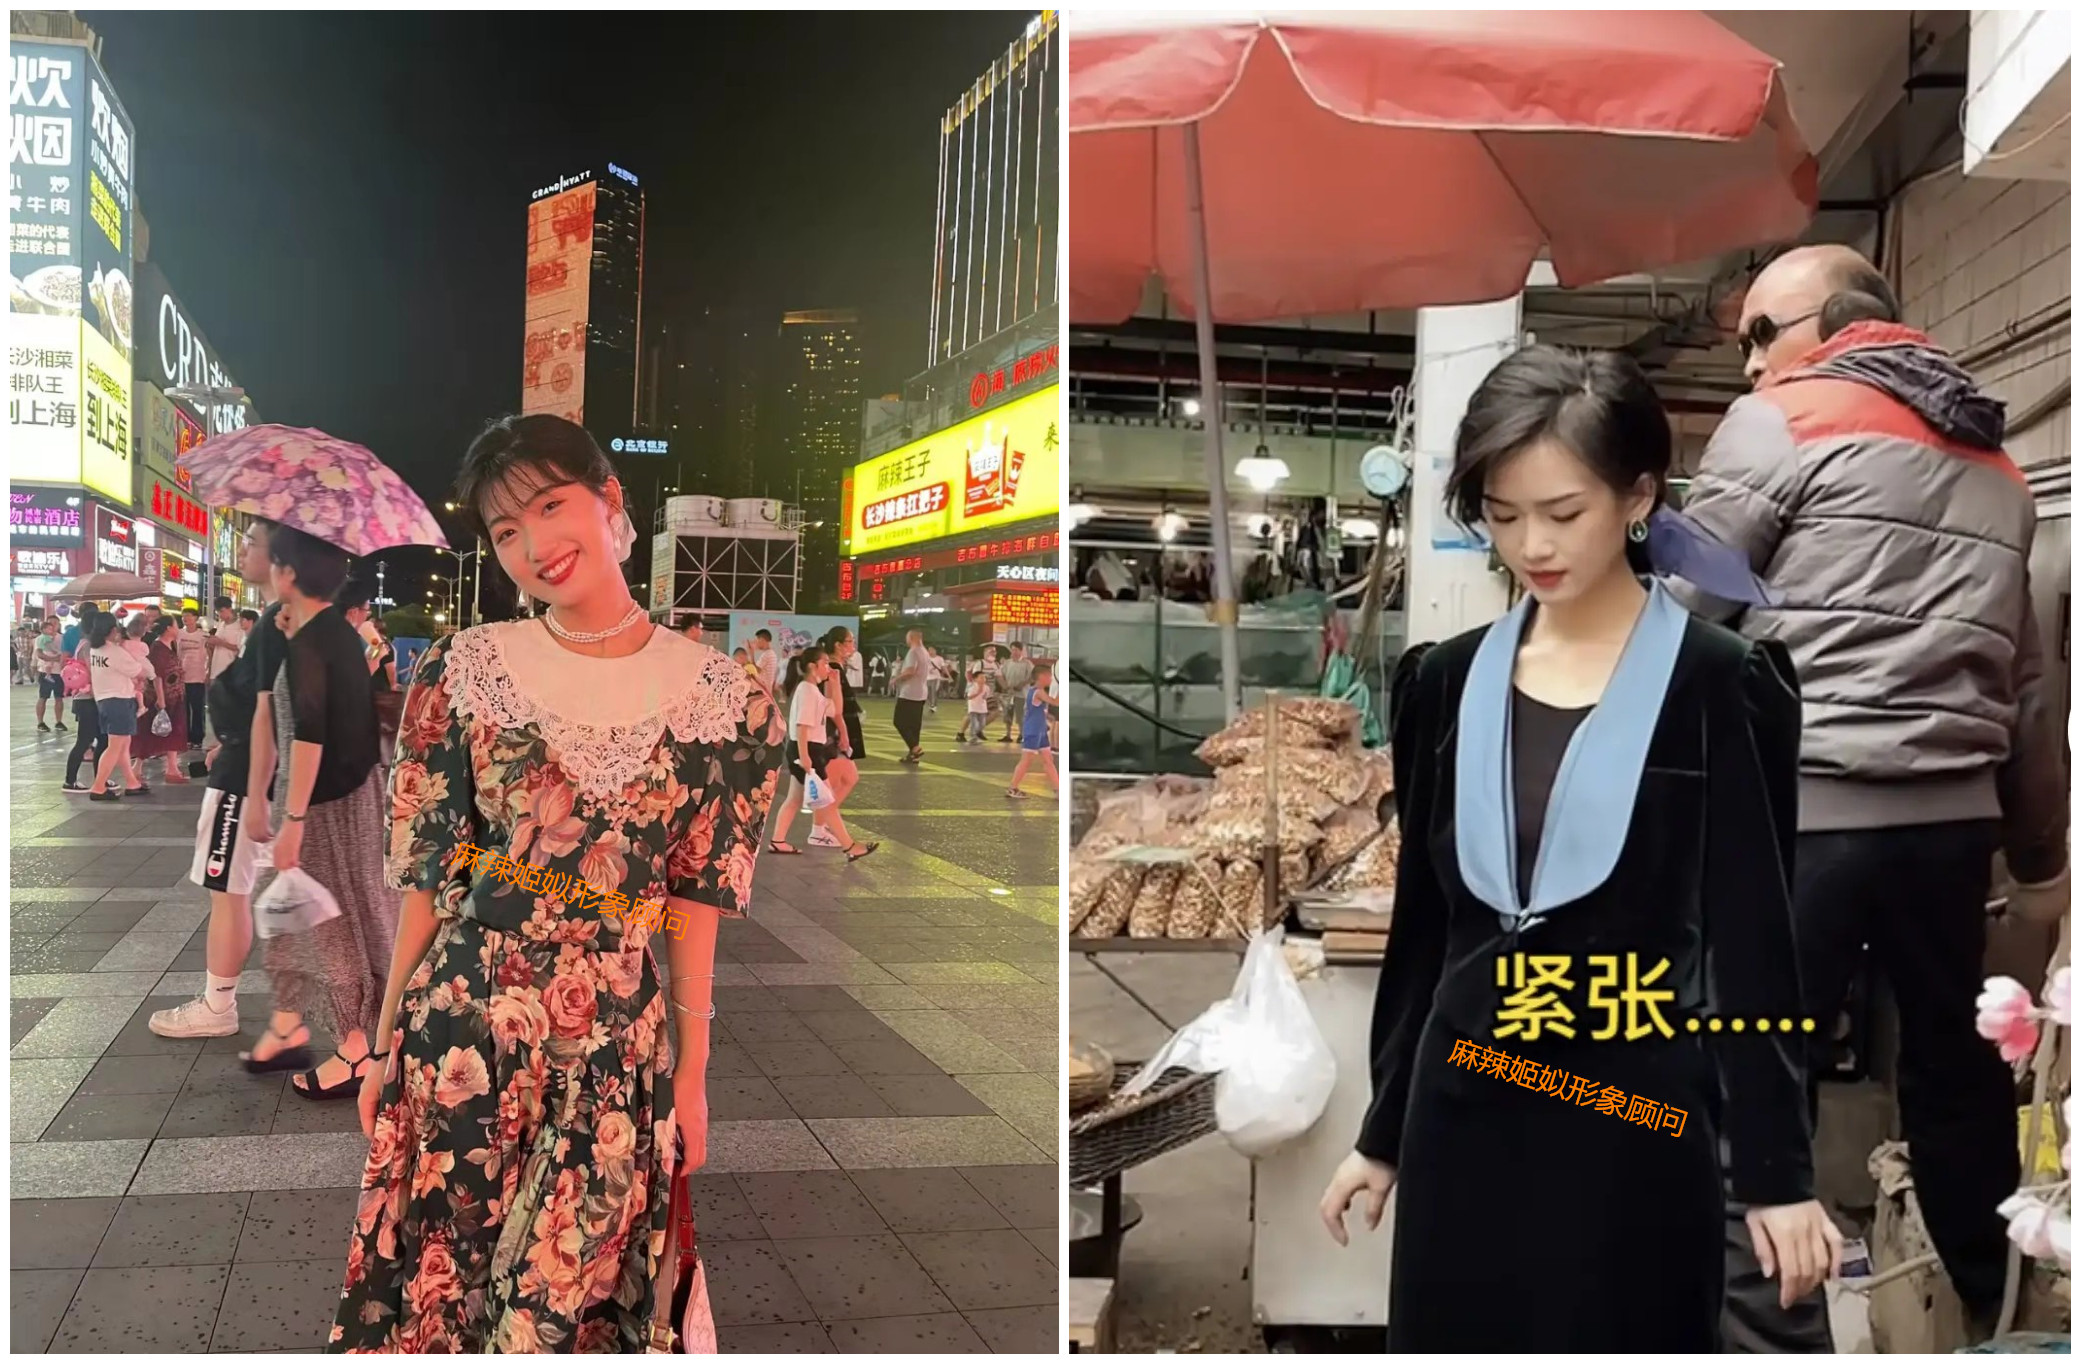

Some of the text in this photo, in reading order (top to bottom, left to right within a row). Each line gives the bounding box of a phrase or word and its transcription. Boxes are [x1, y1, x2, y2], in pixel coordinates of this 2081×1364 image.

[532, 182, 560, 199] GRAND
[562, 169, 591, 188] HYATT
[86, 390, 127, 461] 到上海
[877, 449, 931, 492] 麻辣王子
